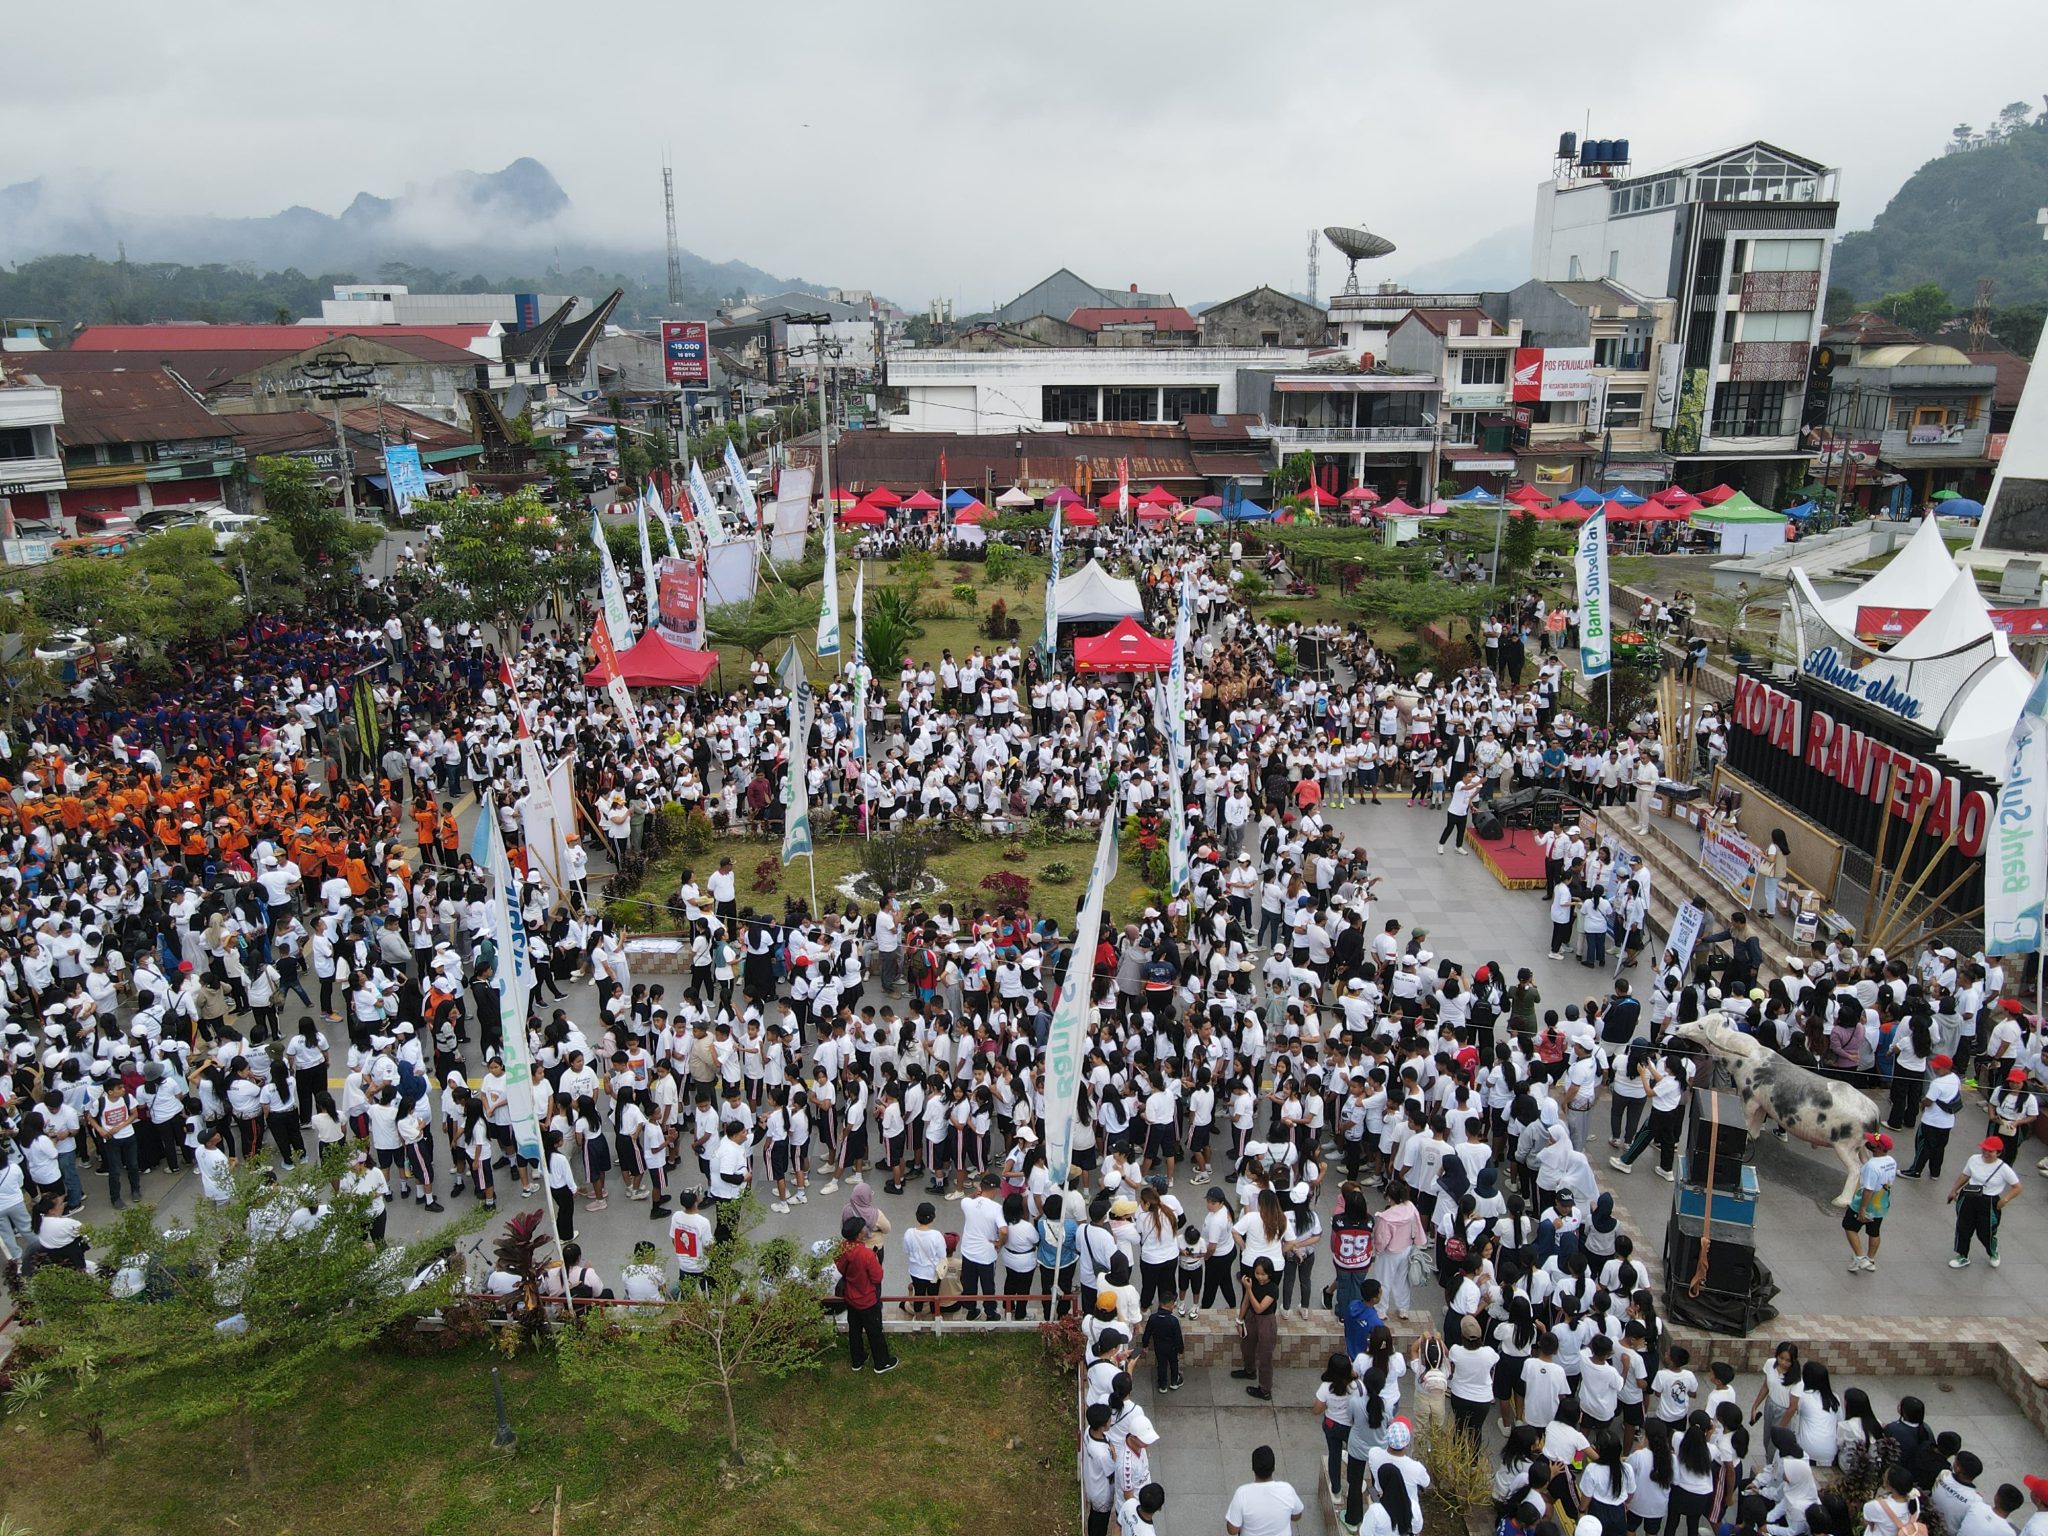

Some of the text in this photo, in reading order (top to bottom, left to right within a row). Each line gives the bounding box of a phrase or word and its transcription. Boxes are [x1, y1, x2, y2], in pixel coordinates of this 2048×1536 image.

[1544, 359, 1593, 371] POS PENJUALAN
[1584, 597, 1604, 638] Bank
[1803, 646, 1921, 719] Alun-alun
[1733, 674, 1995, 858] KOTA RANTEPAO
[1340, 1233, 1370, 1257] 69
